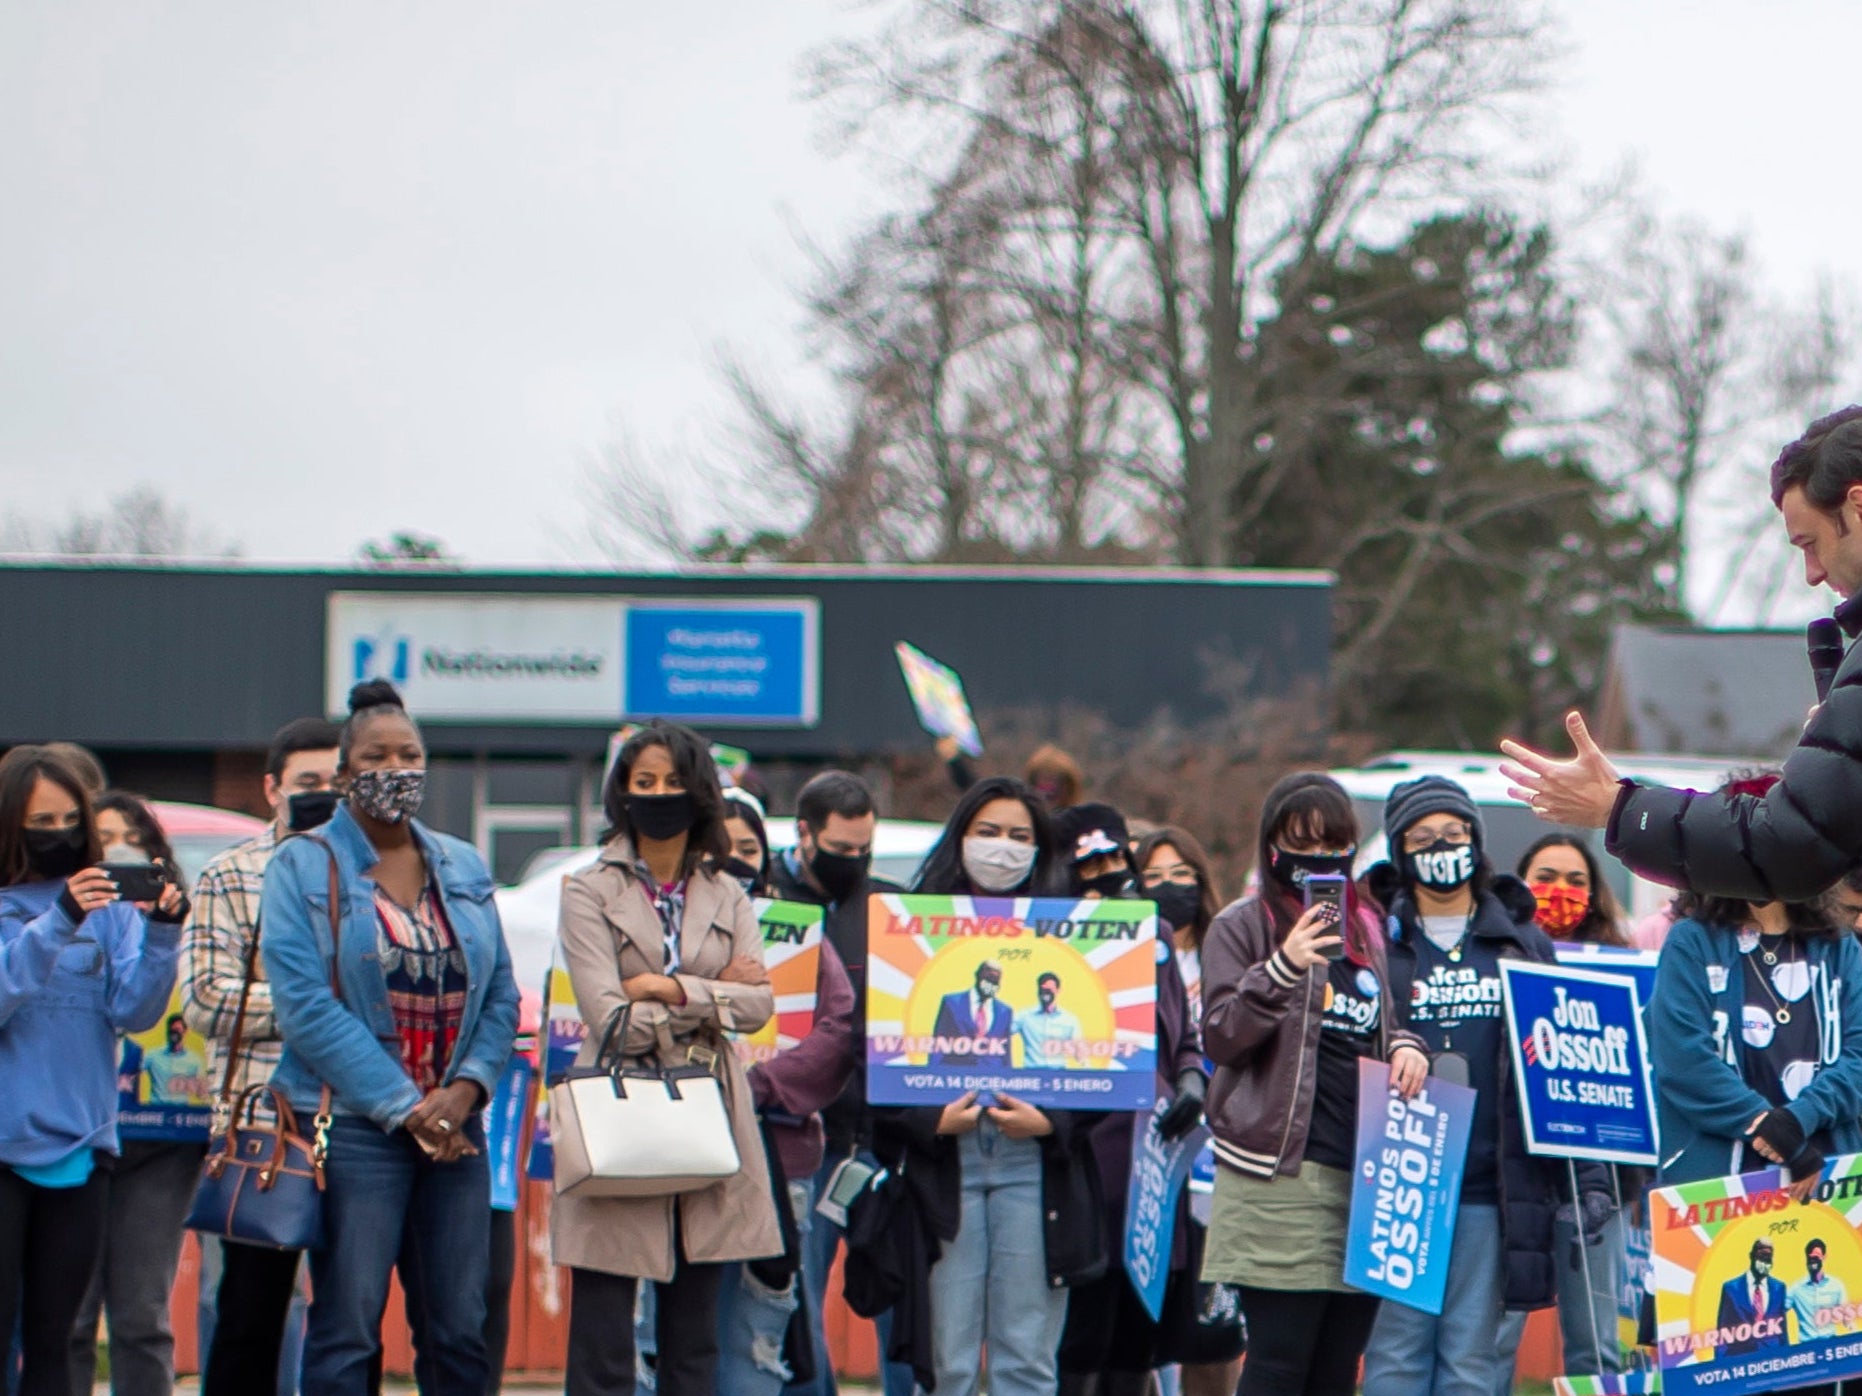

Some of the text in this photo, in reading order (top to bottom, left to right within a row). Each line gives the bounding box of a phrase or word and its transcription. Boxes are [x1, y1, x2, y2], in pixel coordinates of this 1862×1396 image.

[421, 648, 602, 679] Nationwide
[1415, 846, 1474, 884] VOTE
[885, 915, 1142, 940] LATINOS VOTEN
[998, 949, 1032, 960] POR
[1553, 986, 1600, 1031] Jon
[872, 1035, 1008, 1056] WARNOCK
[1042, 1040, 1140, 1058] OSSOFF
[1531, 1017, 1631, 1076] Ossoff
[904, 1075, 943, 1088] VOTA
[947, 1076, 961, 1088] 14
[964, 1076, 1040, 1090] DICIEMBRE
[1053, 1078, 1061, 1090] 5
[1064, 1079, 1112, 1092] ENERO
[1547, 1077, 1634, 1109] U.S. SENATE
[1435, 1112, 1449, 1156] ENERO
[1430, 1178, 1438, 1187] 5
[1432, 1158, 1441, 1175] DE
[1368, 1148, 1400, 1280] LATINOS
[1665, 1187, 1791, 1230] LATINOS
[1768, 1219, 1800, 1235] POR
[1417, 1241, 1428, 1275] VOTA
[1664, 1316, 1784, 1355] WARNOCK
[1695, 1367, 1730, 1386] VOTA
[1732, 1364, 1745, 1379] 14
[1747, 1350, 1816, 1377] DICIEMBRE
[1825, 1349, 1833, 1362] 5
